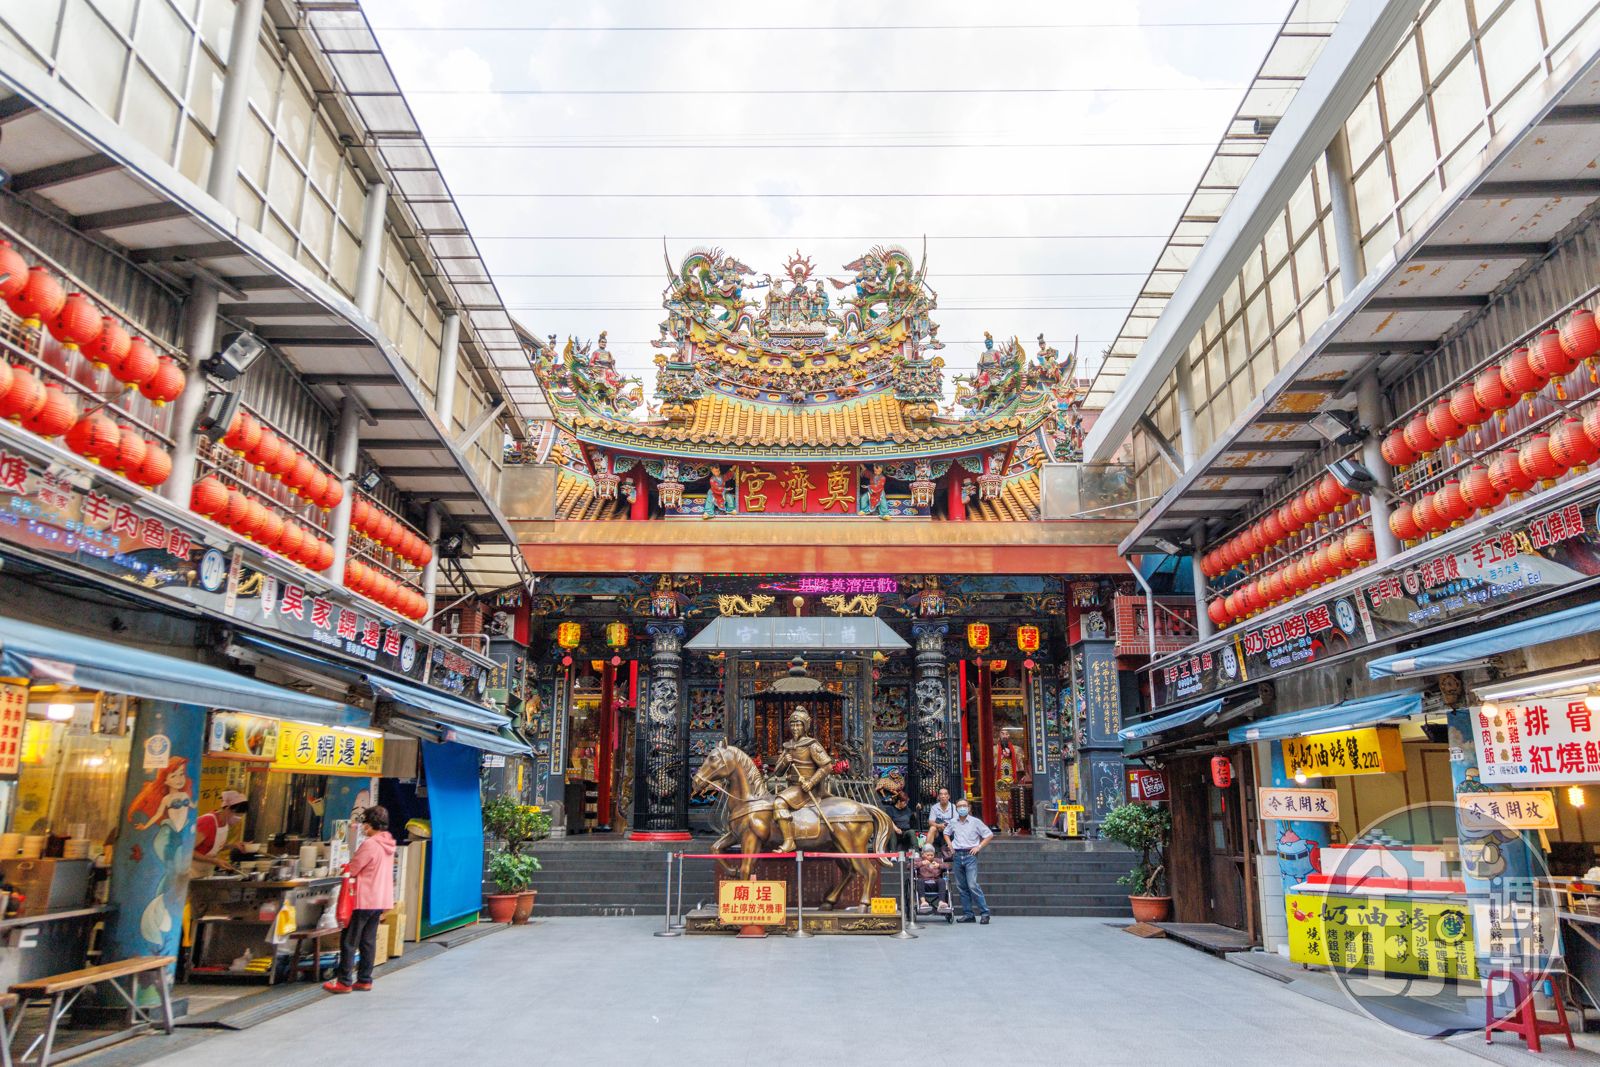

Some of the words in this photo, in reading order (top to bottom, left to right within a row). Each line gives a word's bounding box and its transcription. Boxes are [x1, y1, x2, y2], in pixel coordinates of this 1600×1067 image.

[740, 465, 856, 512] 奠濟宮
[84, 490, 191, 561] 羊肉魯飯
[800, 577, 898, 593] 基隆奠濟宮歡
[1528, 570, 1542, 585] Eel
[1368, 576, 1404, 608] 古早味
[1244, 604, 1333, 656] 奶油螃蟹
[1525, 700, 1592, 737] 排骨
[296, 734, 313, 759] 吳
[1300, 735, 1363, 770] 奶油螃蟹
[1362, 751, 1380, 769] 220
[1215, 759, 1229, 787] 杏仁茶
[1268, 796, 1329, 813] 冷氣開放
[1469, 800, 1544, 821] 冷氣開放
[733, 885, 772, 901] 廟埕
[722, 903, 783, 914] 禁止停放汽機車
